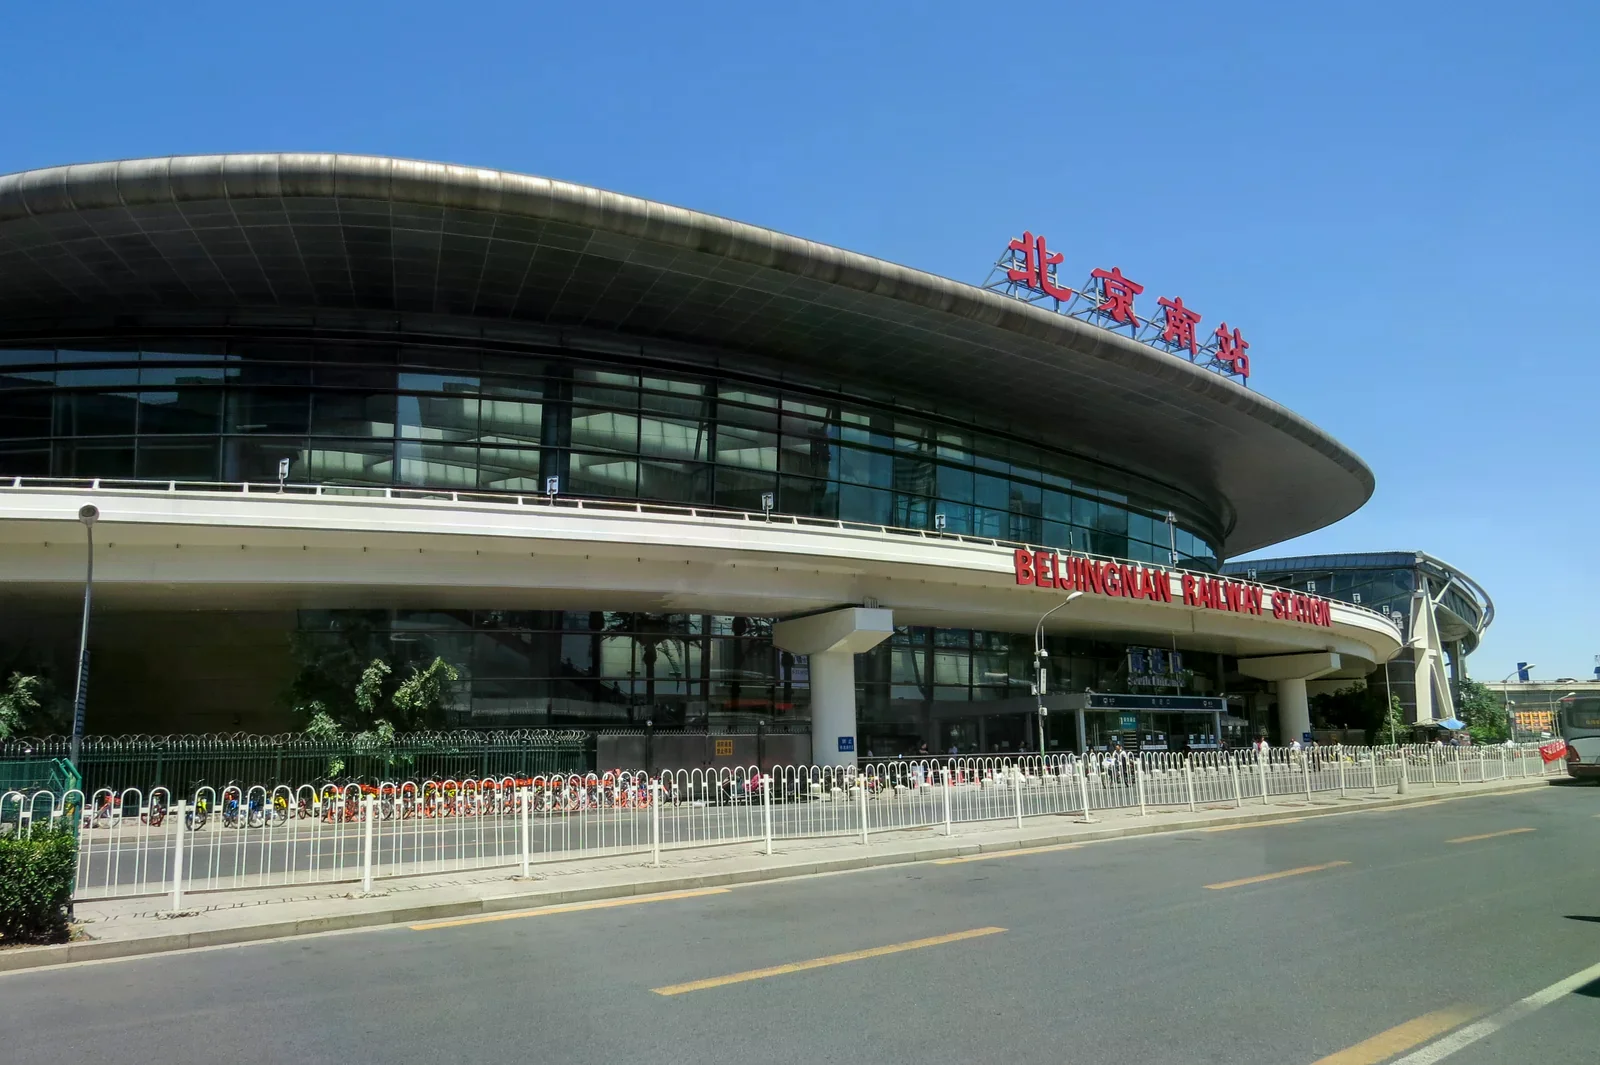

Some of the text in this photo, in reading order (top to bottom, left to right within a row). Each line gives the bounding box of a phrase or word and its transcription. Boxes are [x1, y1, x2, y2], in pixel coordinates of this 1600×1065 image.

[1009, 232, 1249, 376] 北京南站
[1015, 550, 1331, 626] BEIJINGNAN RAILWAY STATION
